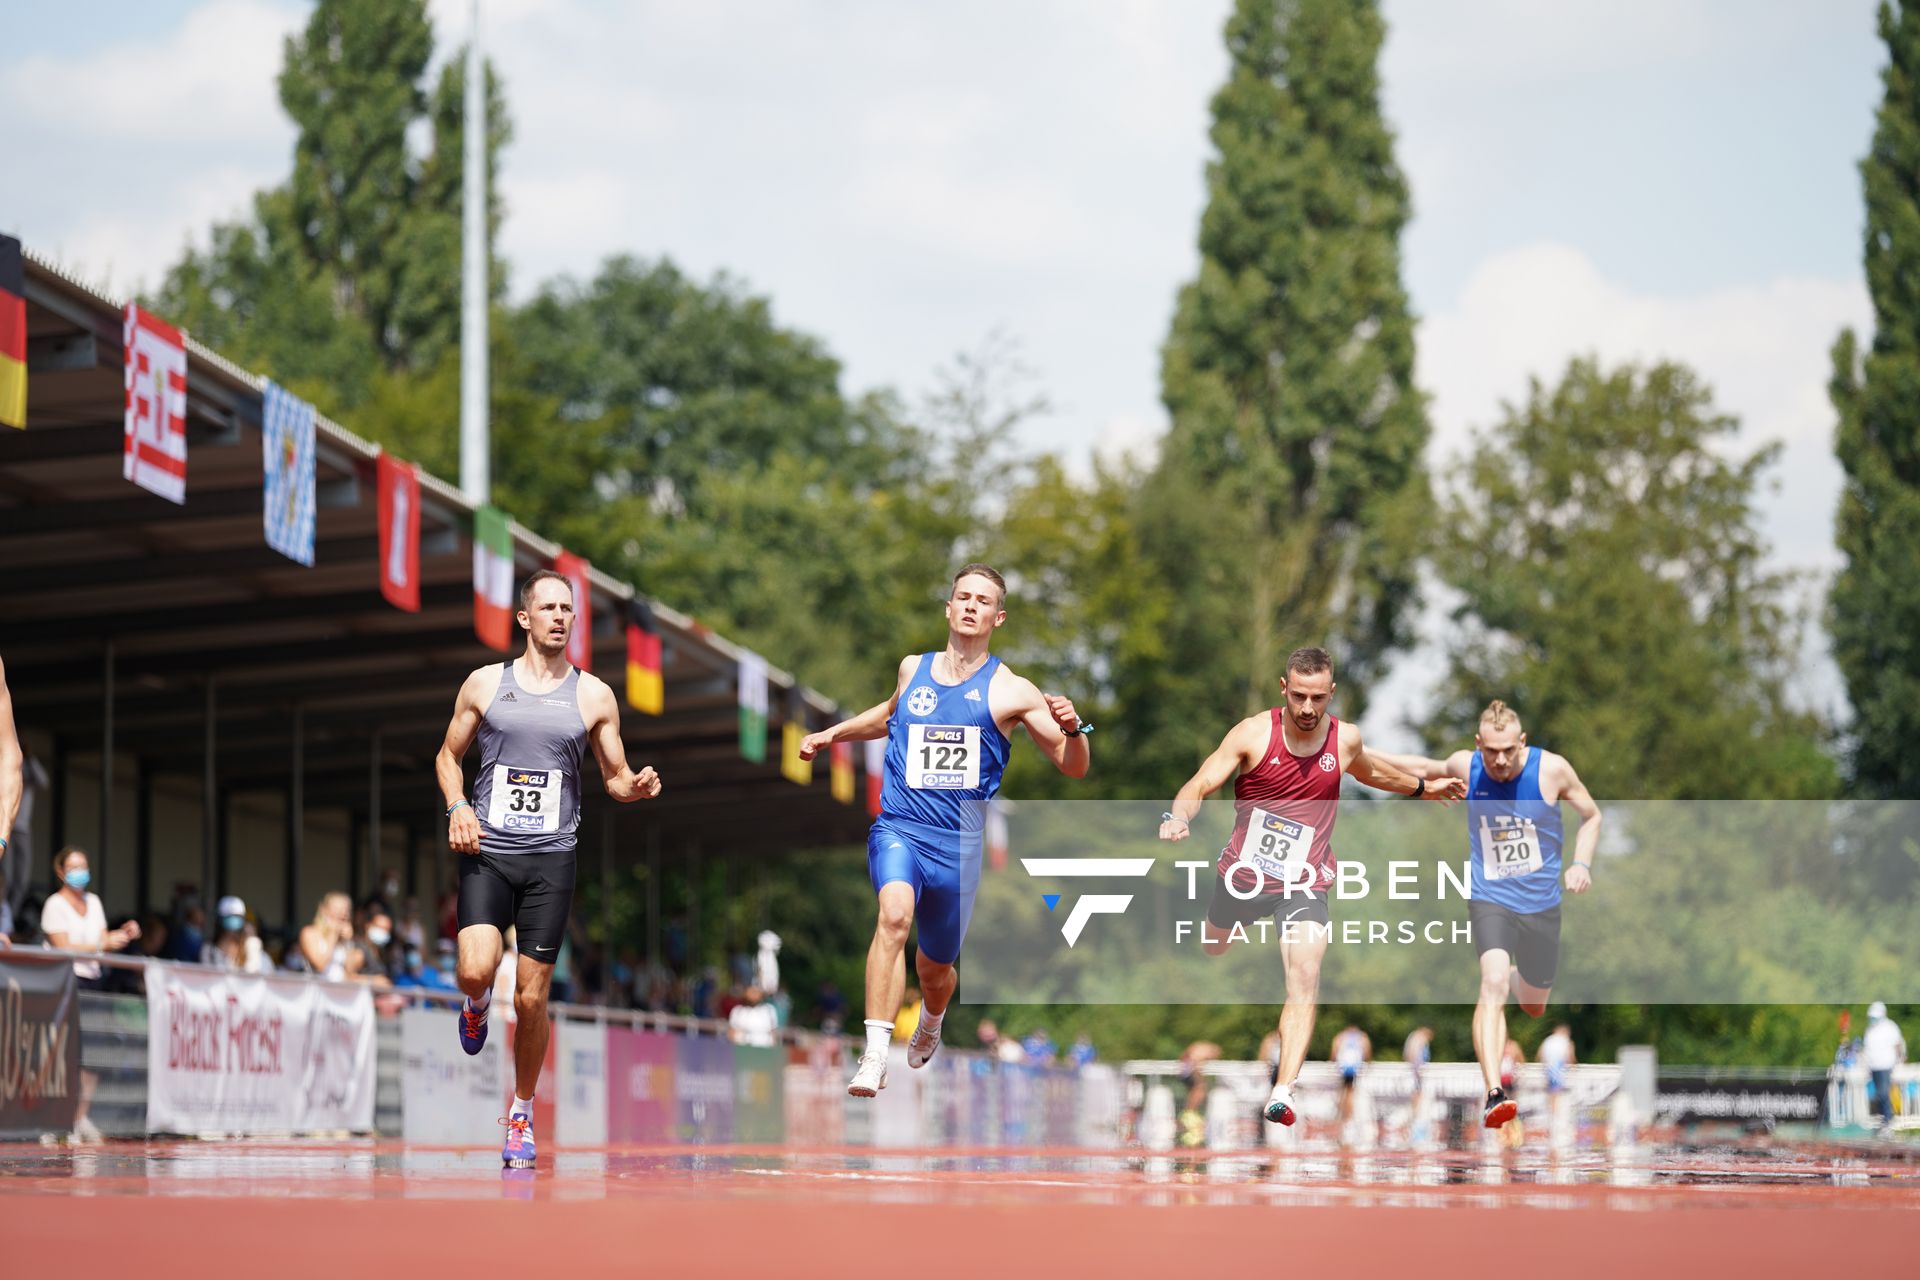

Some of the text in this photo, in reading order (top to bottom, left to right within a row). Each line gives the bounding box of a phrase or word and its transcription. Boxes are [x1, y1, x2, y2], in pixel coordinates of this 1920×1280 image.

[944, 732, 961, 741] GLS
[920, 746, 968, 770] 122
[528, 775, 545, 785] GLS
[939, 775, 962, 783] PLAN
[509, 788, 542, 813] 33
[1282, 825, 1300, 837] GLS
[1258, 833, 1291, 861] 93
[1492, 842, 1530, 863] 120
[167, 988, 221, 1071] Black
[226, 994, 283, 1074] Forest
